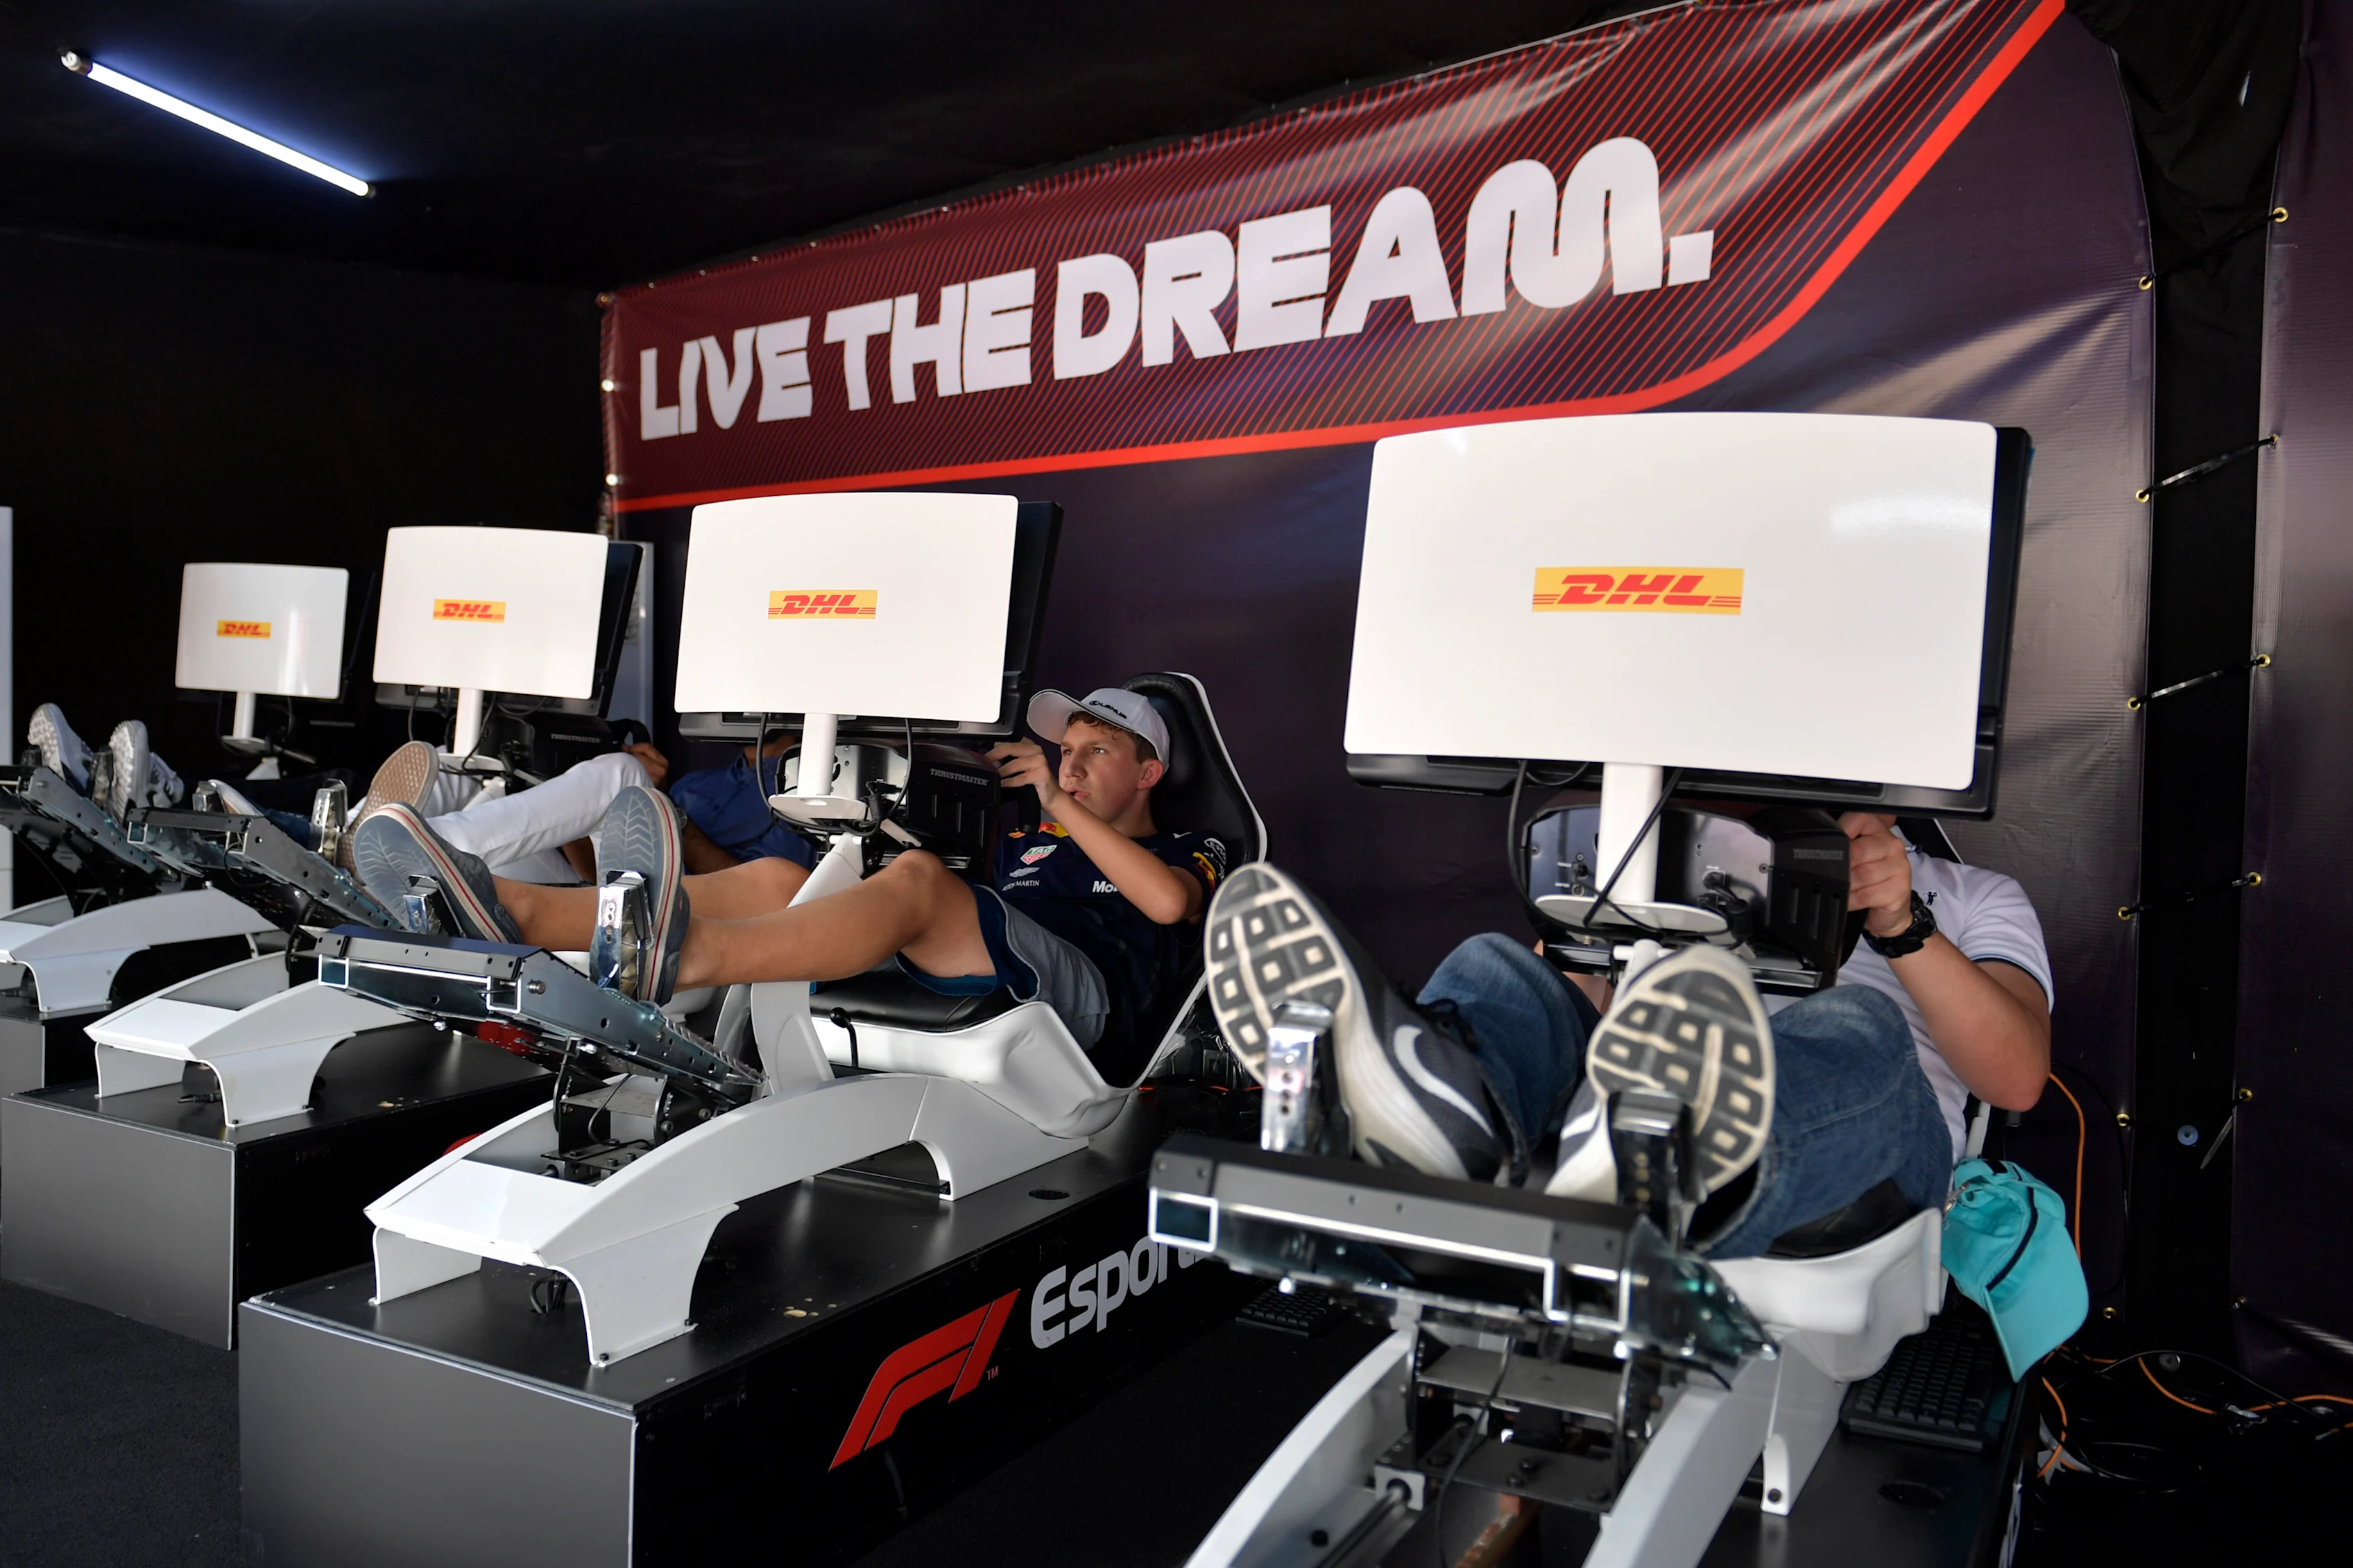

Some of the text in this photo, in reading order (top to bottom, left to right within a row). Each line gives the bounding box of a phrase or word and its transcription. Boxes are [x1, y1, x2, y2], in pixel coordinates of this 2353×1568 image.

[640, 136, 1714, 440] LIVE THE DREAM.
[1557, 574, 1713, 607] DHL
[442, 603, 493, 619] DHL
[780, 594, 861, 614] DHL
[223, 623, 262, 636] DHL
[930, 768, 988, 786] THRUSTMASTER
[1028, 845, 1056, 854] TAG
[1092, 880, 1119, 893] Mo
